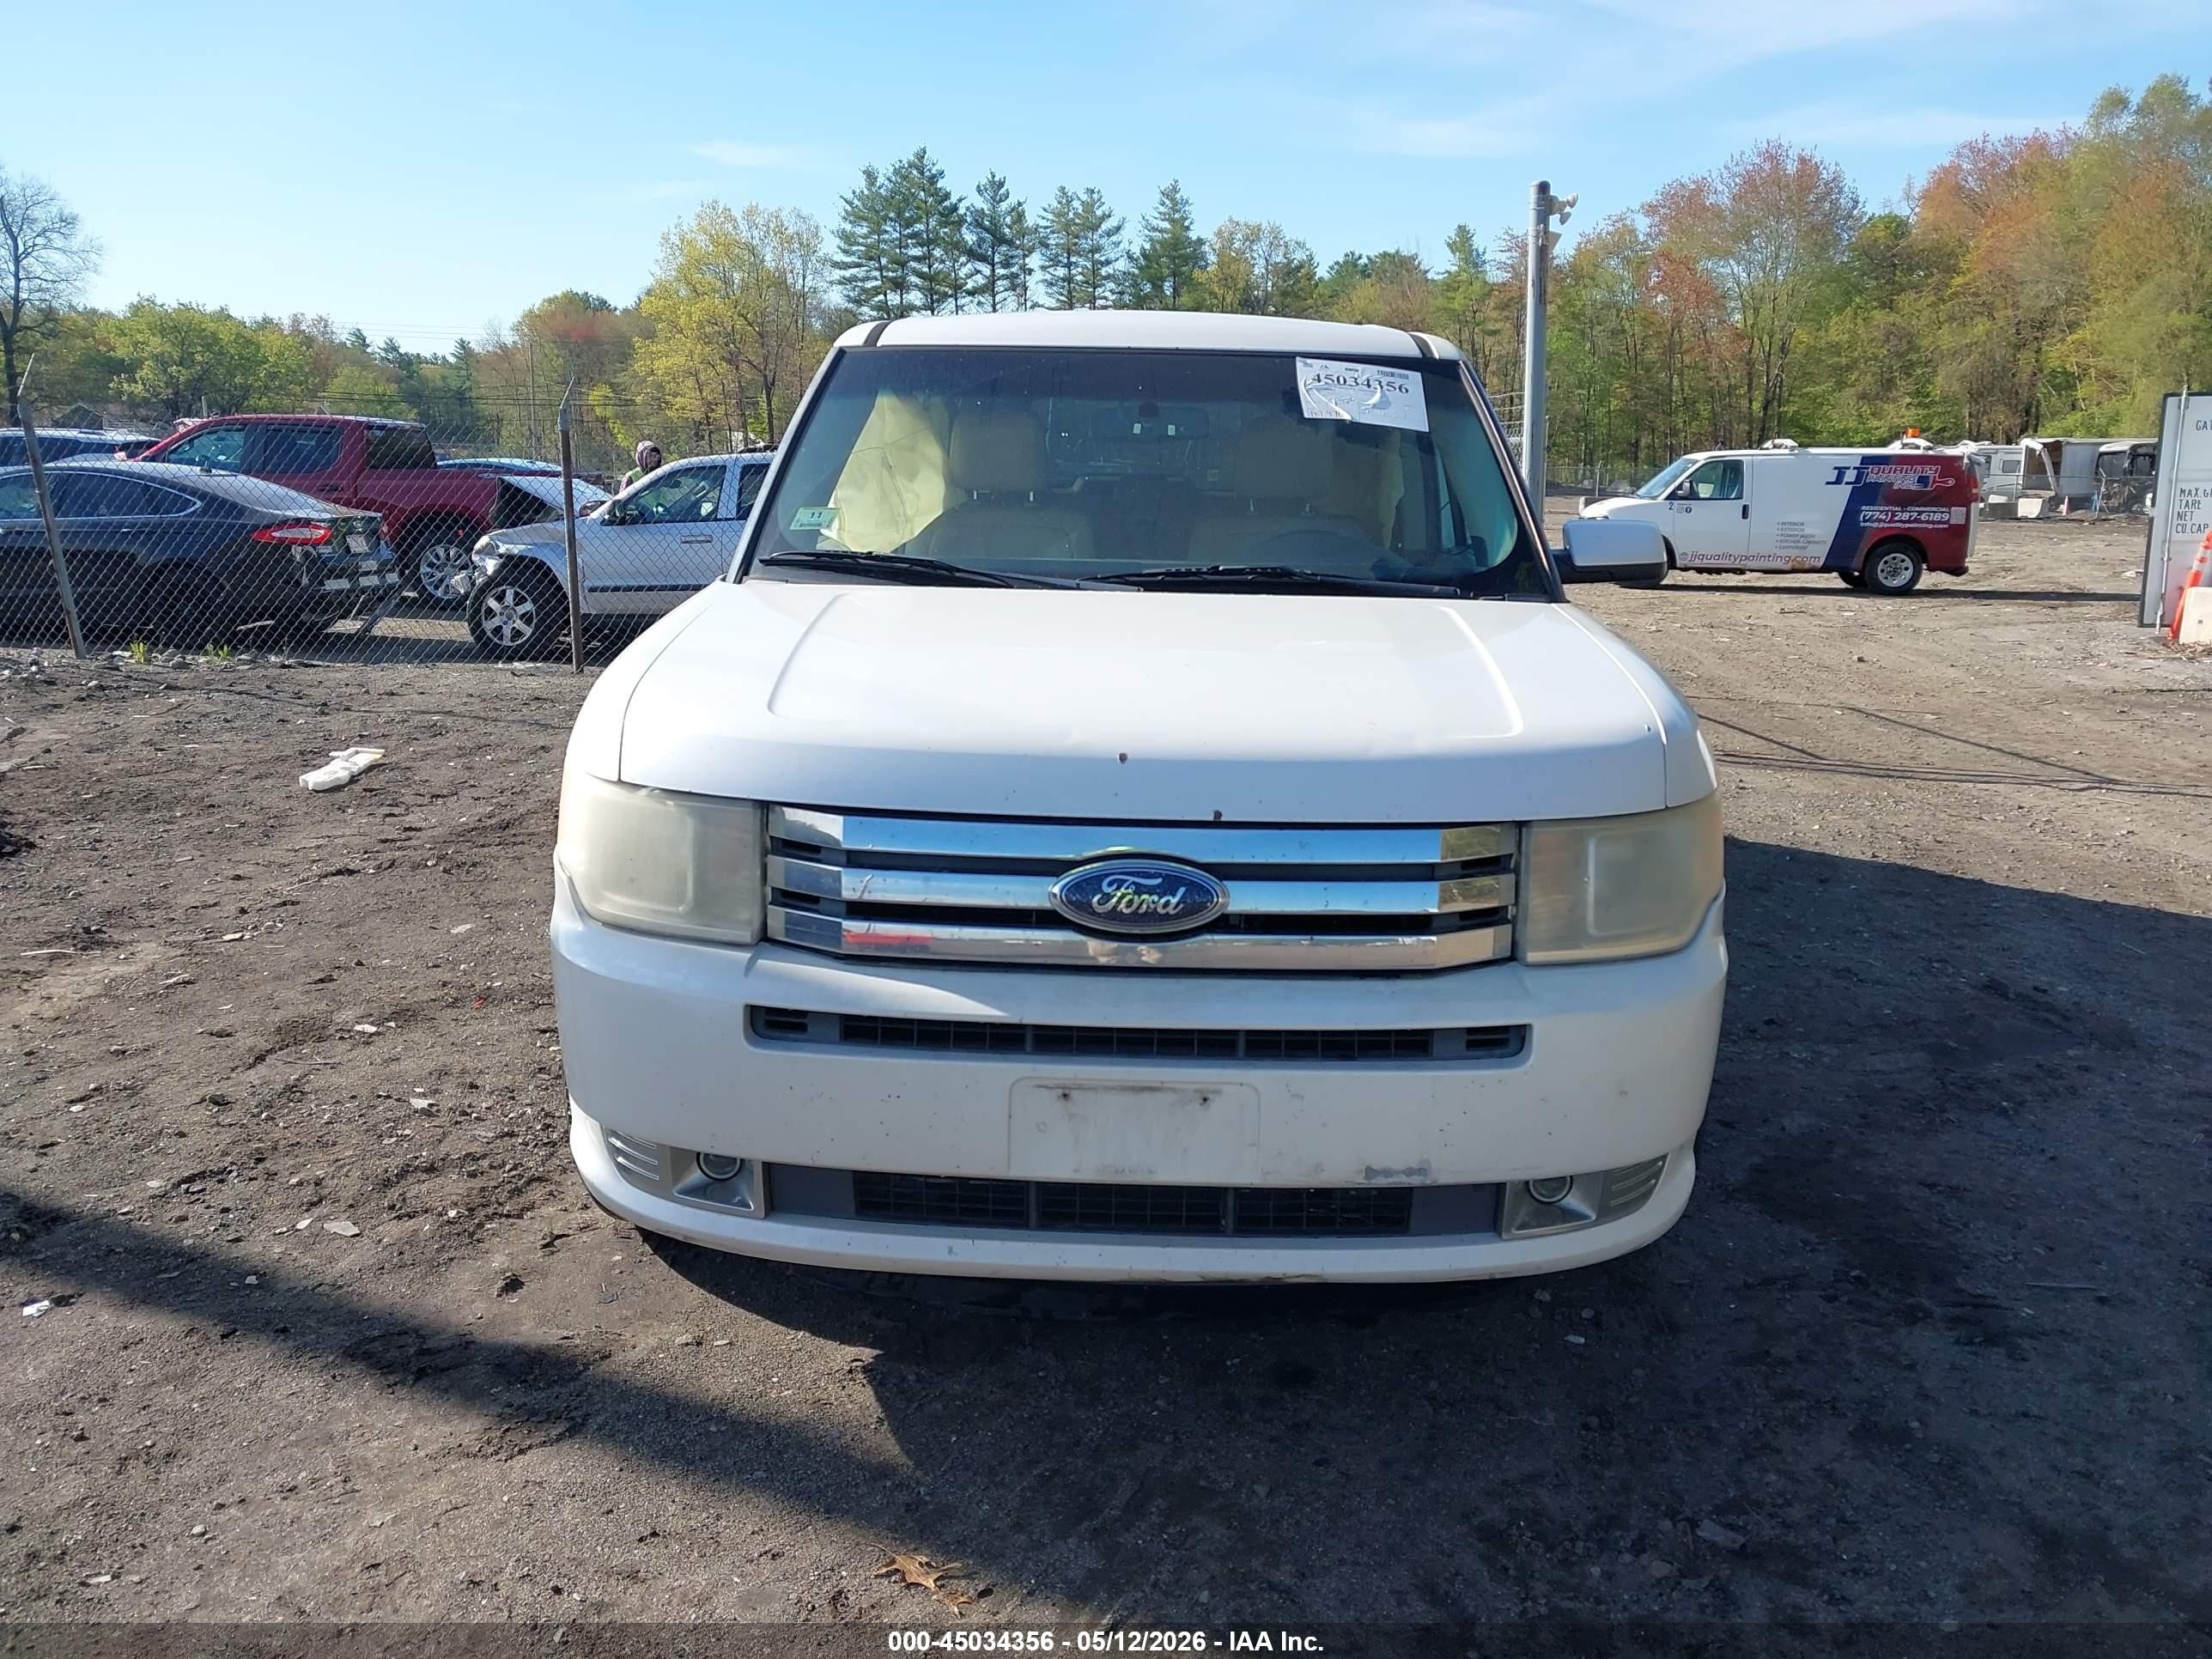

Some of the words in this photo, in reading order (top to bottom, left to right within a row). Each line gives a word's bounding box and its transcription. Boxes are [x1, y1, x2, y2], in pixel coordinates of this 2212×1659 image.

[1310, 373, 1409, 395] 45034356
[2196, 420, 2212, 431] GA
[1869, 465, 1940, 475] QUALITY
[2179, 487, 2212, 498] MAX.G
[1668, 501, 1674, 510] 2
[2179, 499, 2202, 510] TARE
[1860, 511, 1892, 521] (774)
[1893, 513, 1950, 521] 287-6189
[2176, 511, 2194, 522] NET
[1689, 551, 1821, 564] jjqualitypainting.com
[1091, 874, 1186, 915] Ford
